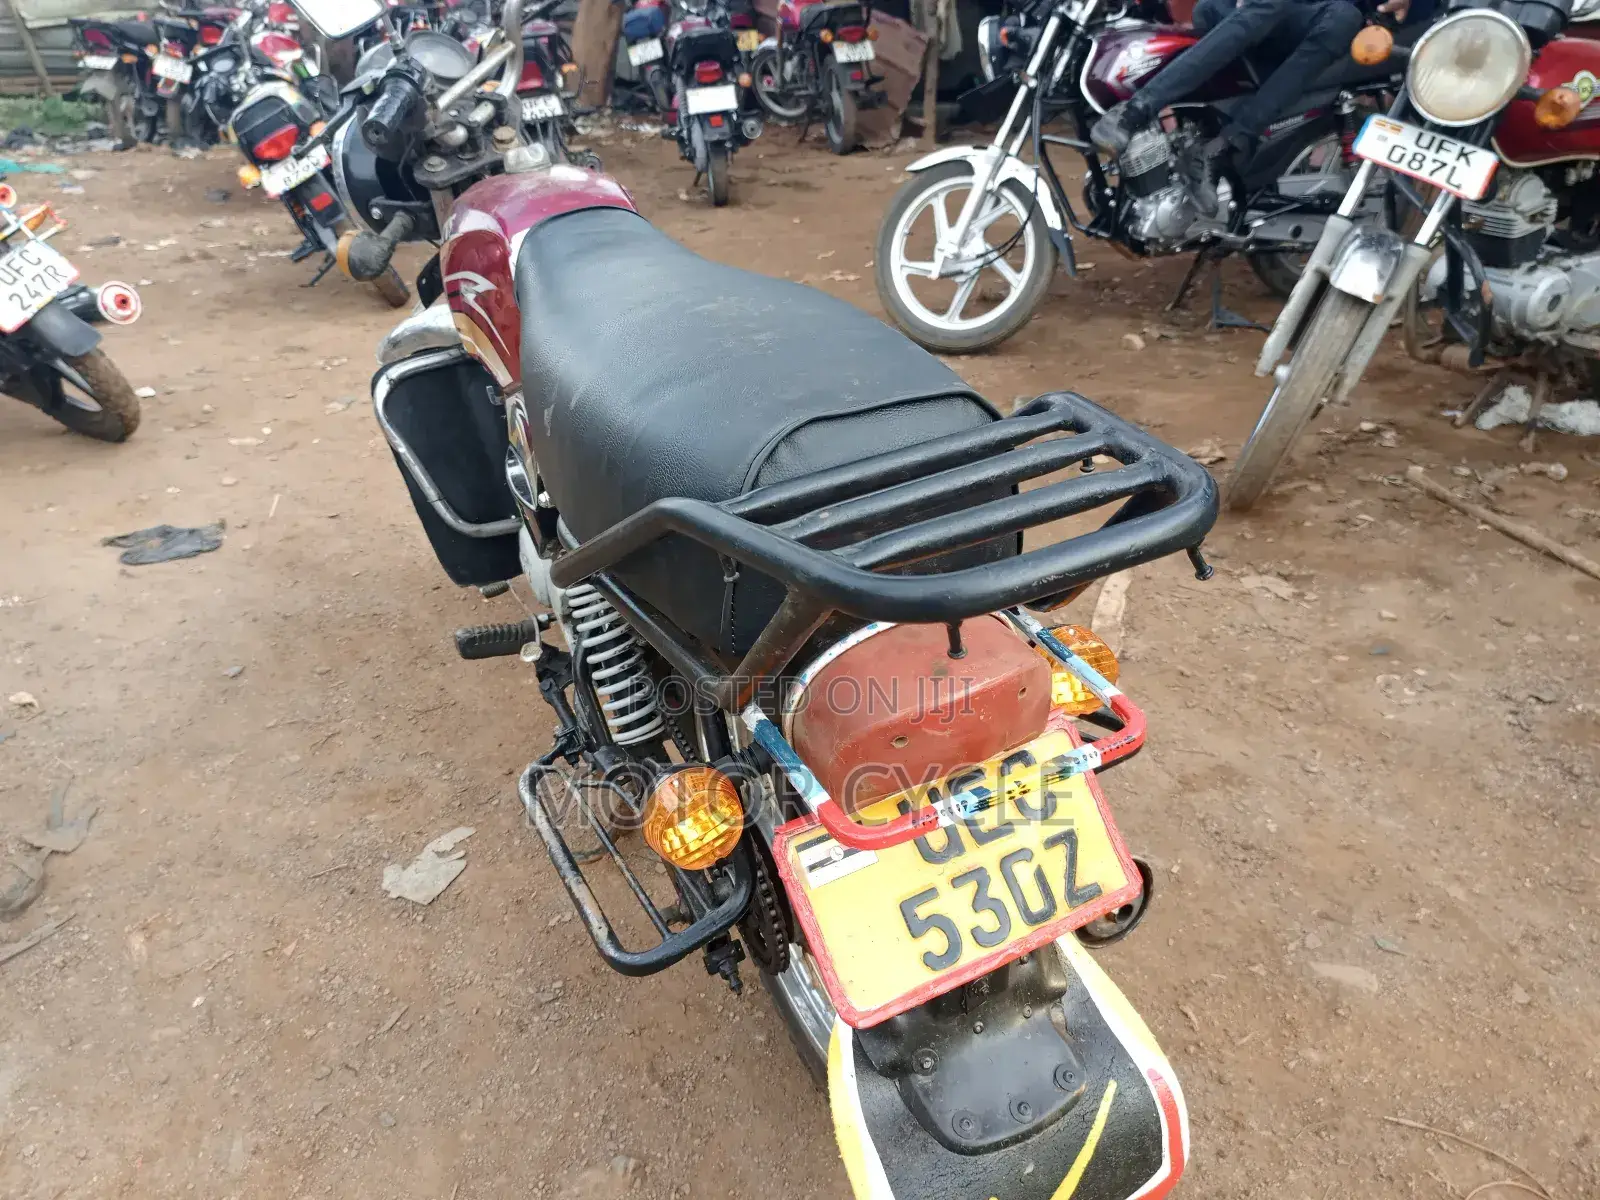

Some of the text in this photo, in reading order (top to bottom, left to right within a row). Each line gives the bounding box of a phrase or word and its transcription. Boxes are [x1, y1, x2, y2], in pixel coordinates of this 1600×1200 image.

[1387, 145, 1462, 189] 087L
[1415, 132, 1477, 167] UFK
[0, 249, 42, 285] UFC
[9, 265, 67, 311] 247R
[900, 828, 1103, 971] 530Z
